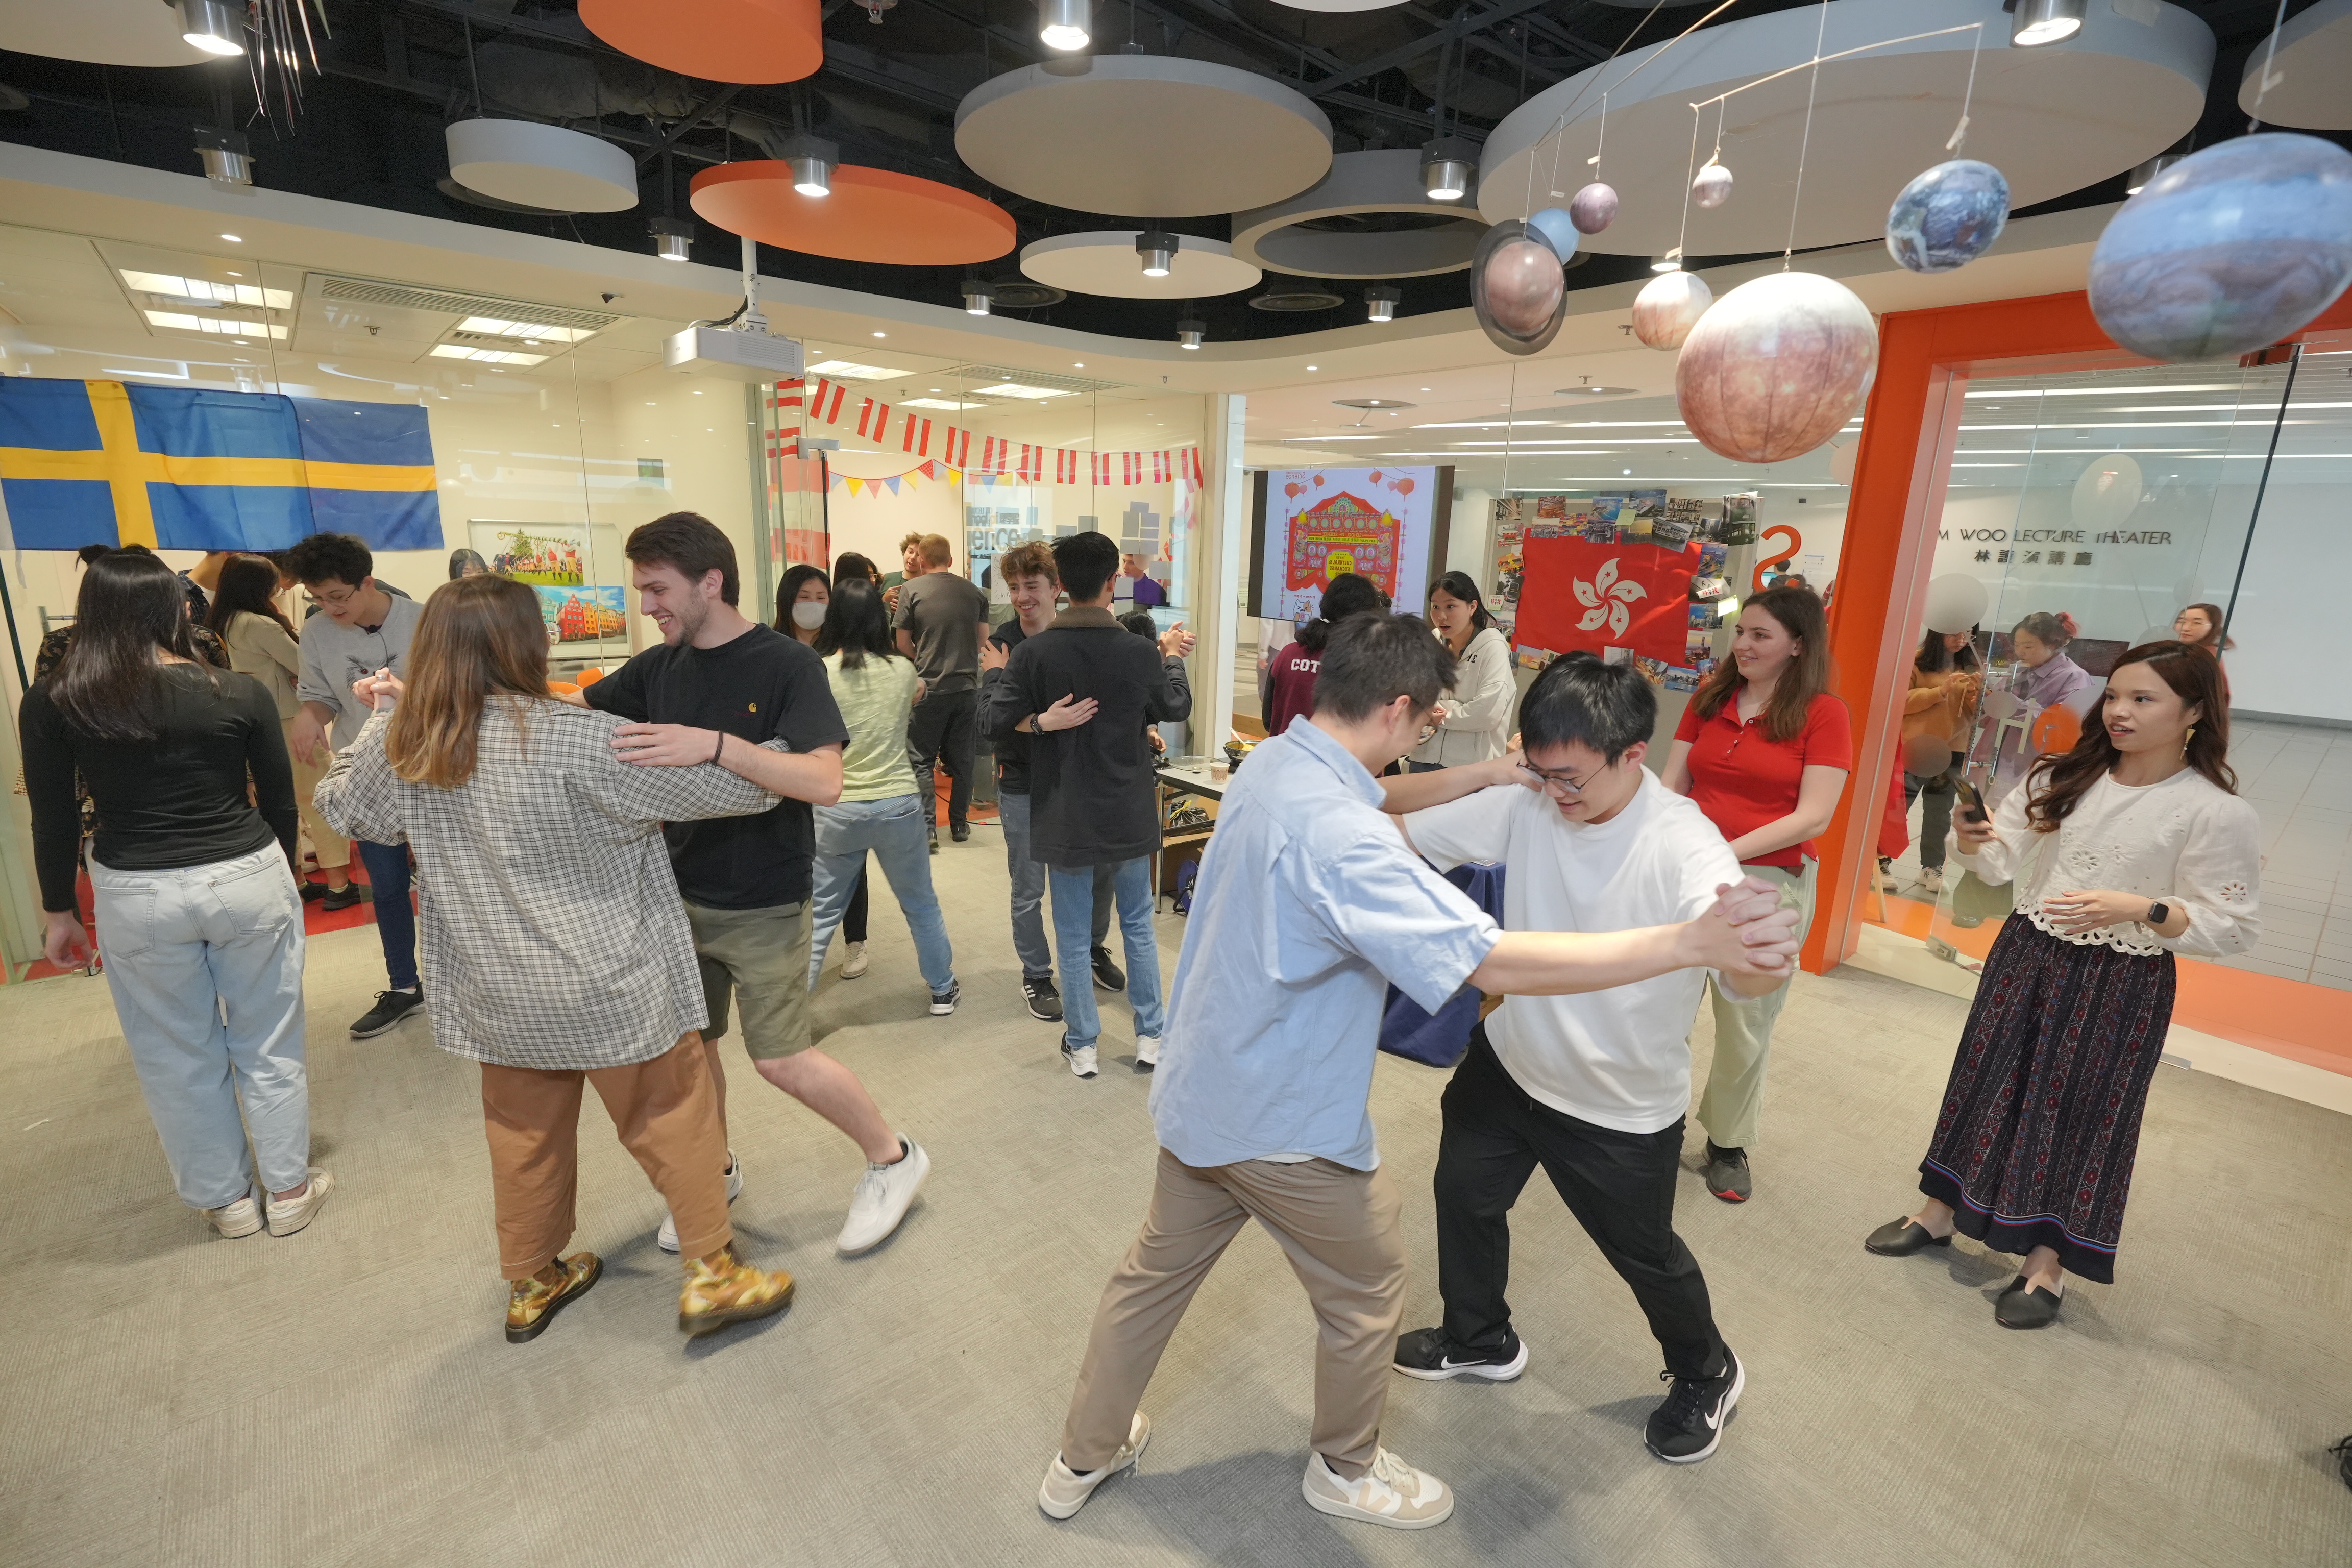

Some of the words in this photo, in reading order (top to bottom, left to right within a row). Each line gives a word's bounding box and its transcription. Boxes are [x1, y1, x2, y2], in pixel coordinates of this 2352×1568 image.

[1960, 529, 2006, 541] WOO
[2014, 530, 2086, 543] LECTURE
[2095, 531, 2172, 545] THEATER
